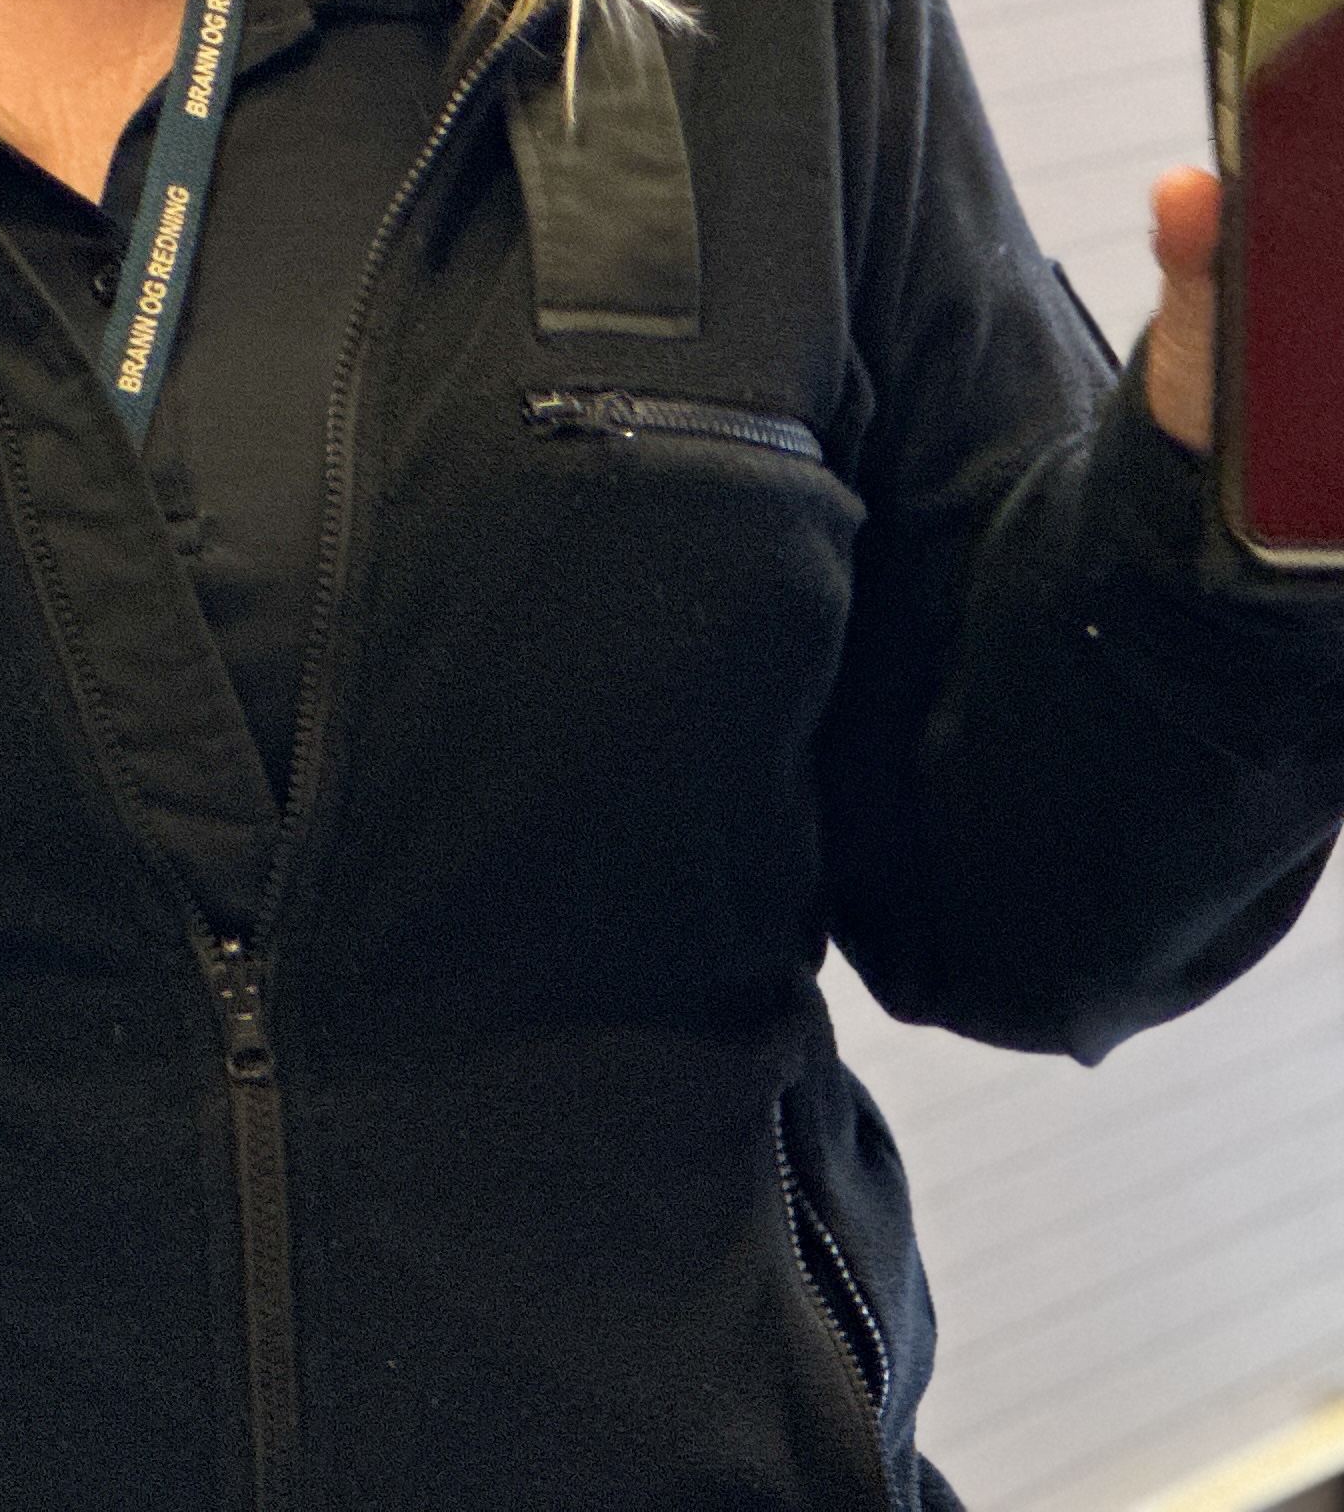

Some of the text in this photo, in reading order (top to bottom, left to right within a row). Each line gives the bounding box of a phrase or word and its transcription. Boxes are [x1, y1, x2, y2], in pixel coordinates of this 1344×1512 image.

[201, 12, 227, 45] OG
[185, 44, 220, 118] BRANN
[117, 184, 190, 394] BRANN OG REDNING
